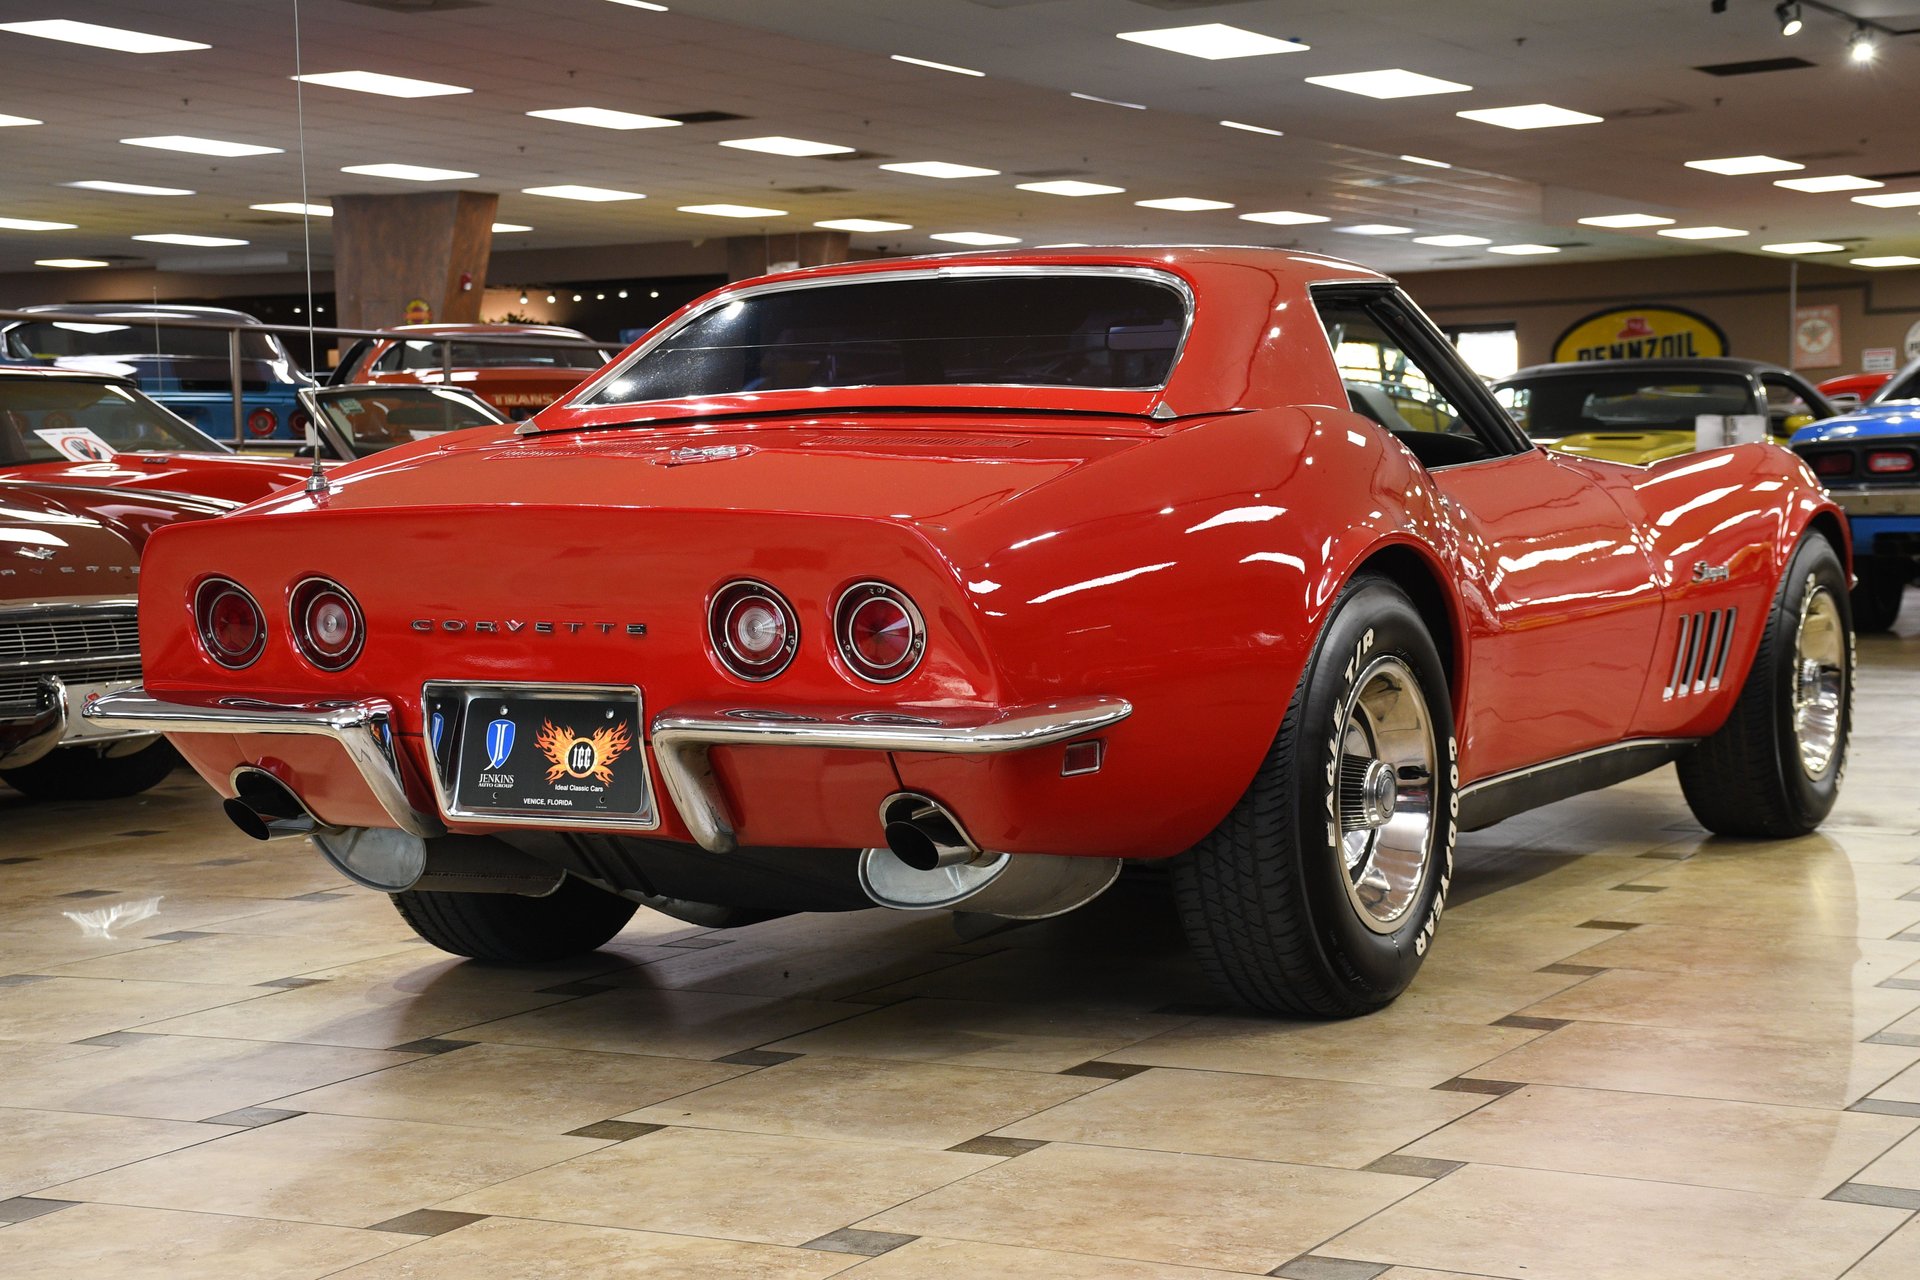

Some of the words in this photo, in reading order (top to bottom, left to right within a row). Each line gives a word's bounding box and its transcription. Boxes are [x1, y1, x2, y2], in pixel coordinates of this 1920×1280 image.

[492, 393, 554, 406] TRANS
[411, 619, 647, 635] CORVETTE
[478, 773, 515, 784] JENKINS
[1326, 698, 1343, 847] EAGLE
[569, 784, 589, 792] Classic
[523, 798, 546, 806] VENICE,
[1415, 736, 1459, 957] GOODYEAR
